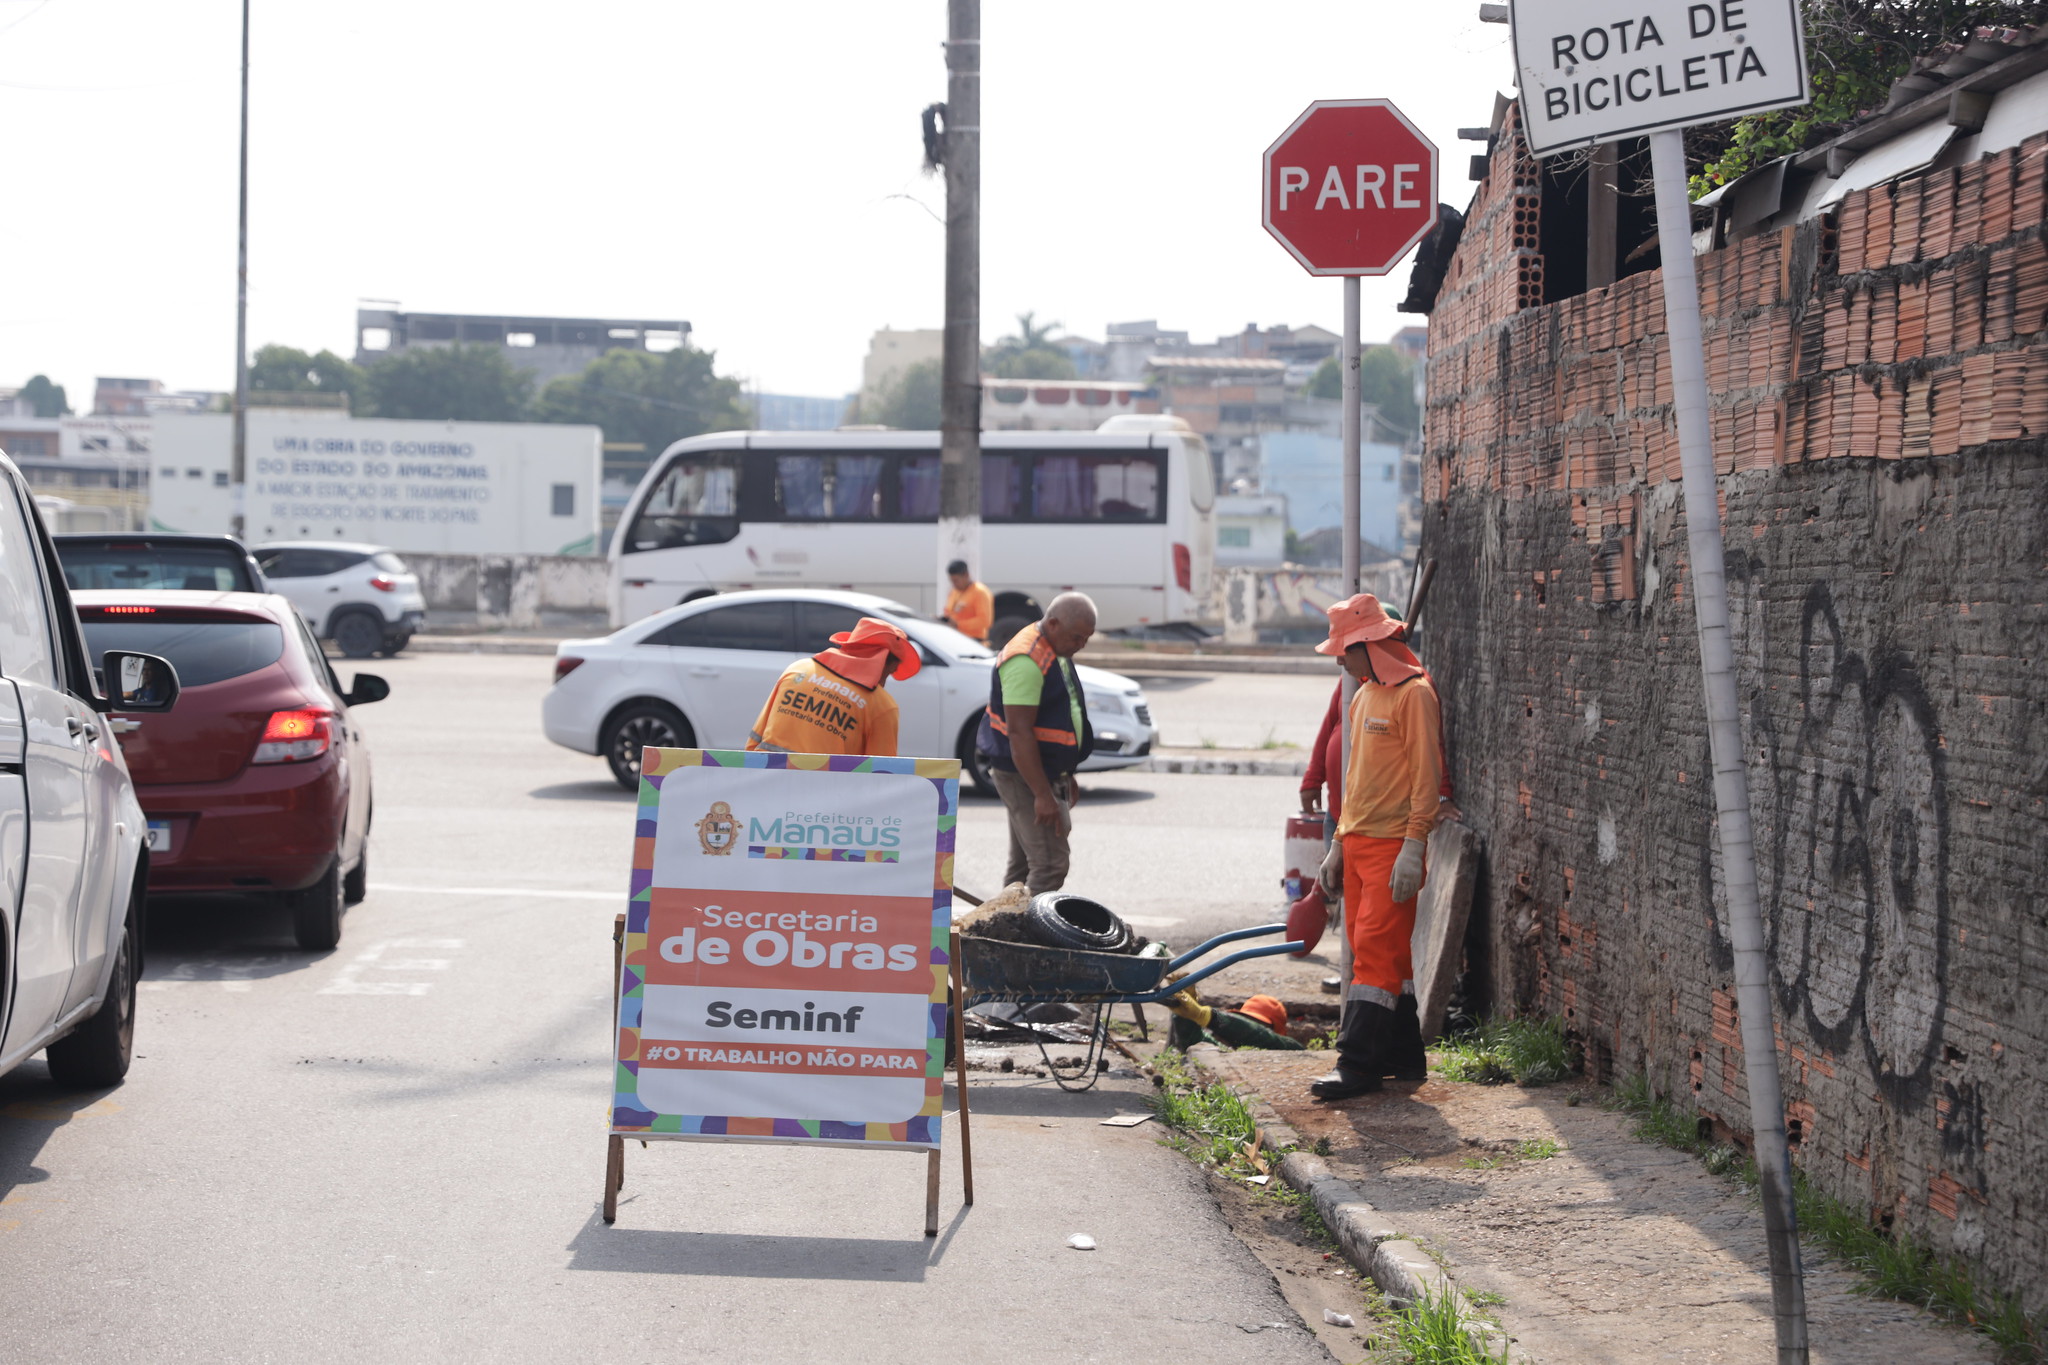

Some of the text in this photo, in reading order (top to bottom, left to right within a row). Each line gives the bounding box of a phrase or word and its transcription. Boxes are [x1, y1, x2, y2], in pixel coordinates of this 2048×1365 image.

[1552, 0, 1747, 70] ROTA DE
[1544, 46, 1767, 121] BICICLETA
[1279, 164, 1421, 211] PARE
[273, 437, 475, 458] UMA OBRA DO GOVERNO
[256, 458, 489, 480] DO ESTADO DO AMAZONAS
[807, 673, 869, 709] Manaus
[812, 687, 852, 709] Prefeitura
[777, 706, 813, 723] Secretaria
[814, 718, 826, 728] de
[780, 689, 858, 732] SEMINF
[749, 817, 901, 847] Manaus
[785, 812, 902, 826] Prefeitura de
[703, 905, 878, 933] Secretaria
[659, 927, 918, 972] de Obras
[705, 1001, 864, 1033] Seminf
[647, 1046, 918, 1070] #O TRABALHO NÃO PARA
